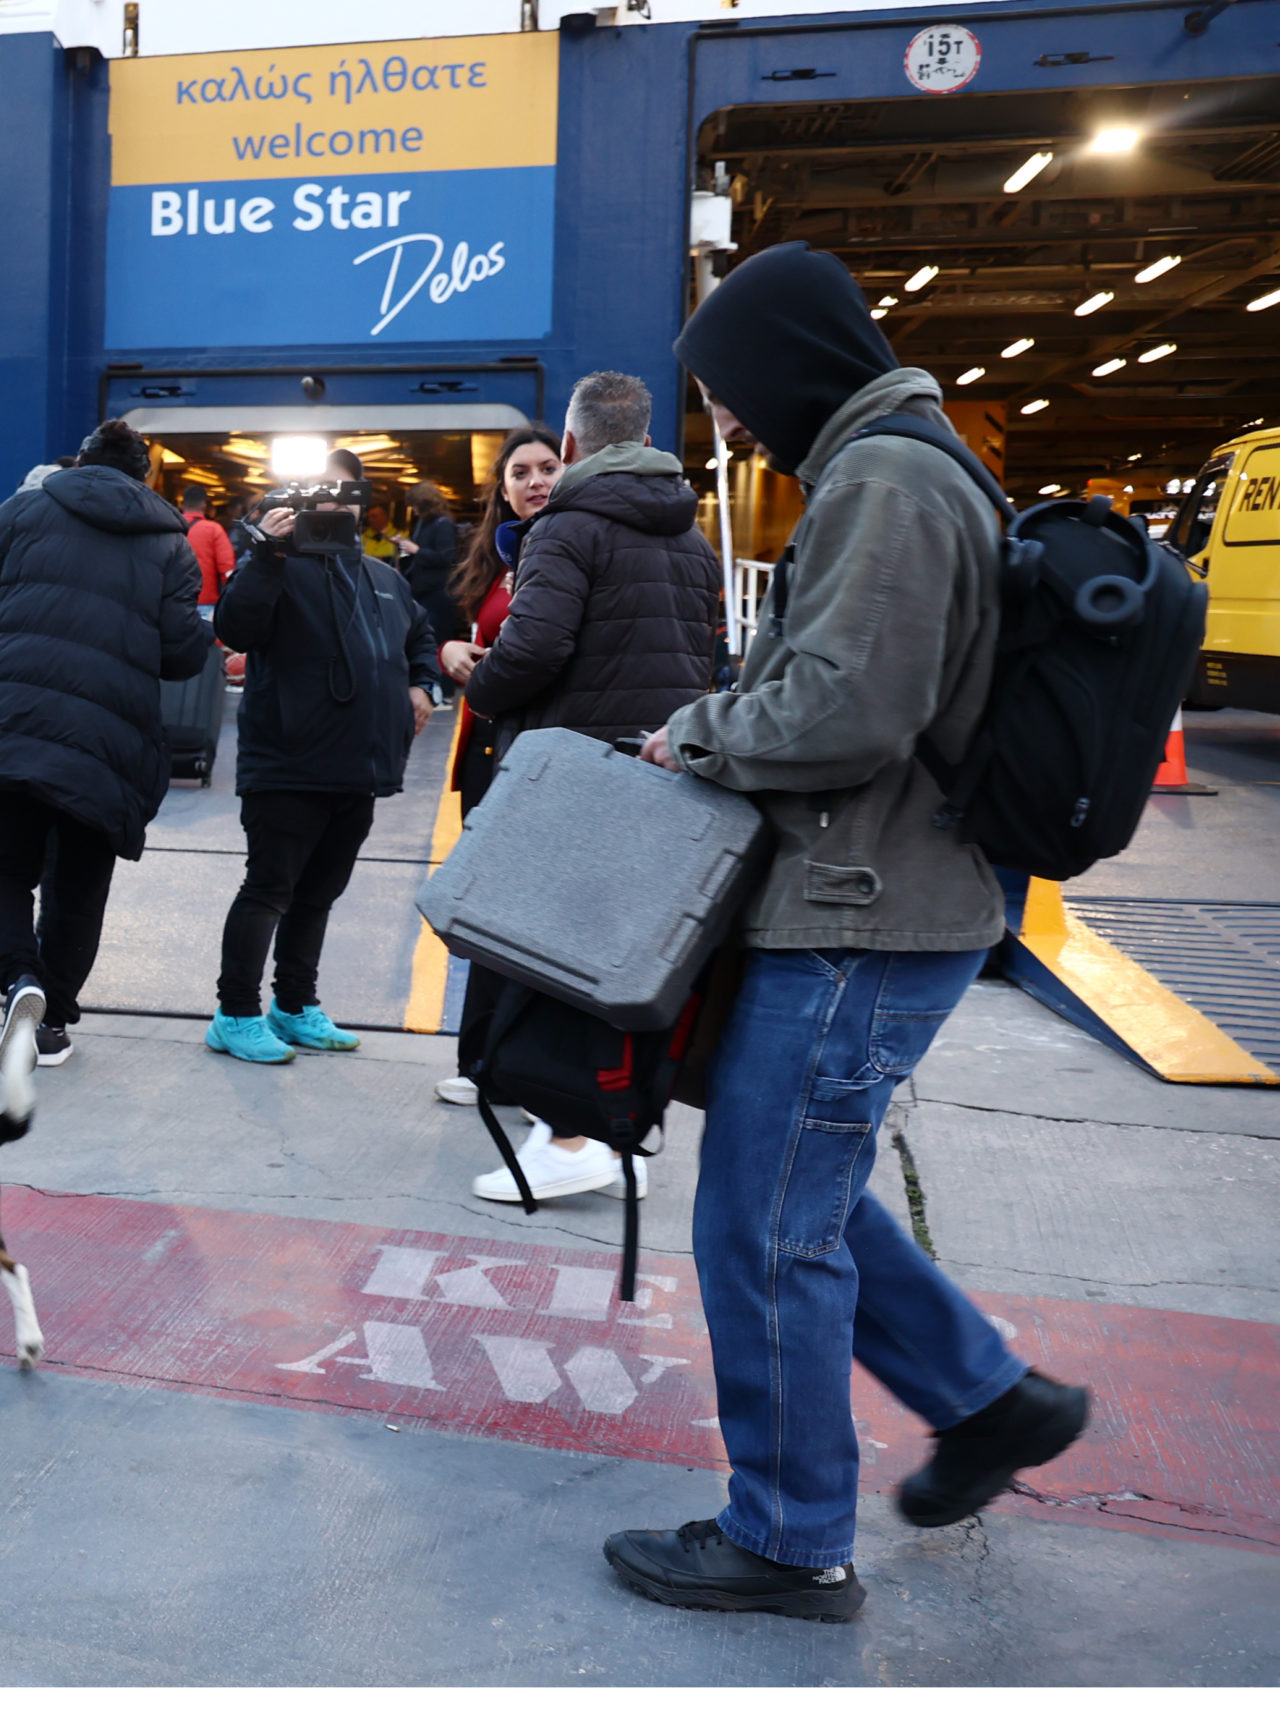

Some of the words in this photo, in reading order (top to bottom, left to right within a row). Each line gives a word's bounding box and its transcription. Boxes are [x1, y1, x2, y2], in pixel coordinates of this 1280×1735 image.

[177, 63, 313, 105] καλώς
[329, 55, 488, 105] ήλθατε
[232, 122, 424, 161] welcome
[151, 189, 275, 236] Blue
[292, 183, 412, 232] Star
[352, 232, 506, 336] Delos
[1239, 476, 1280, 512] REN
